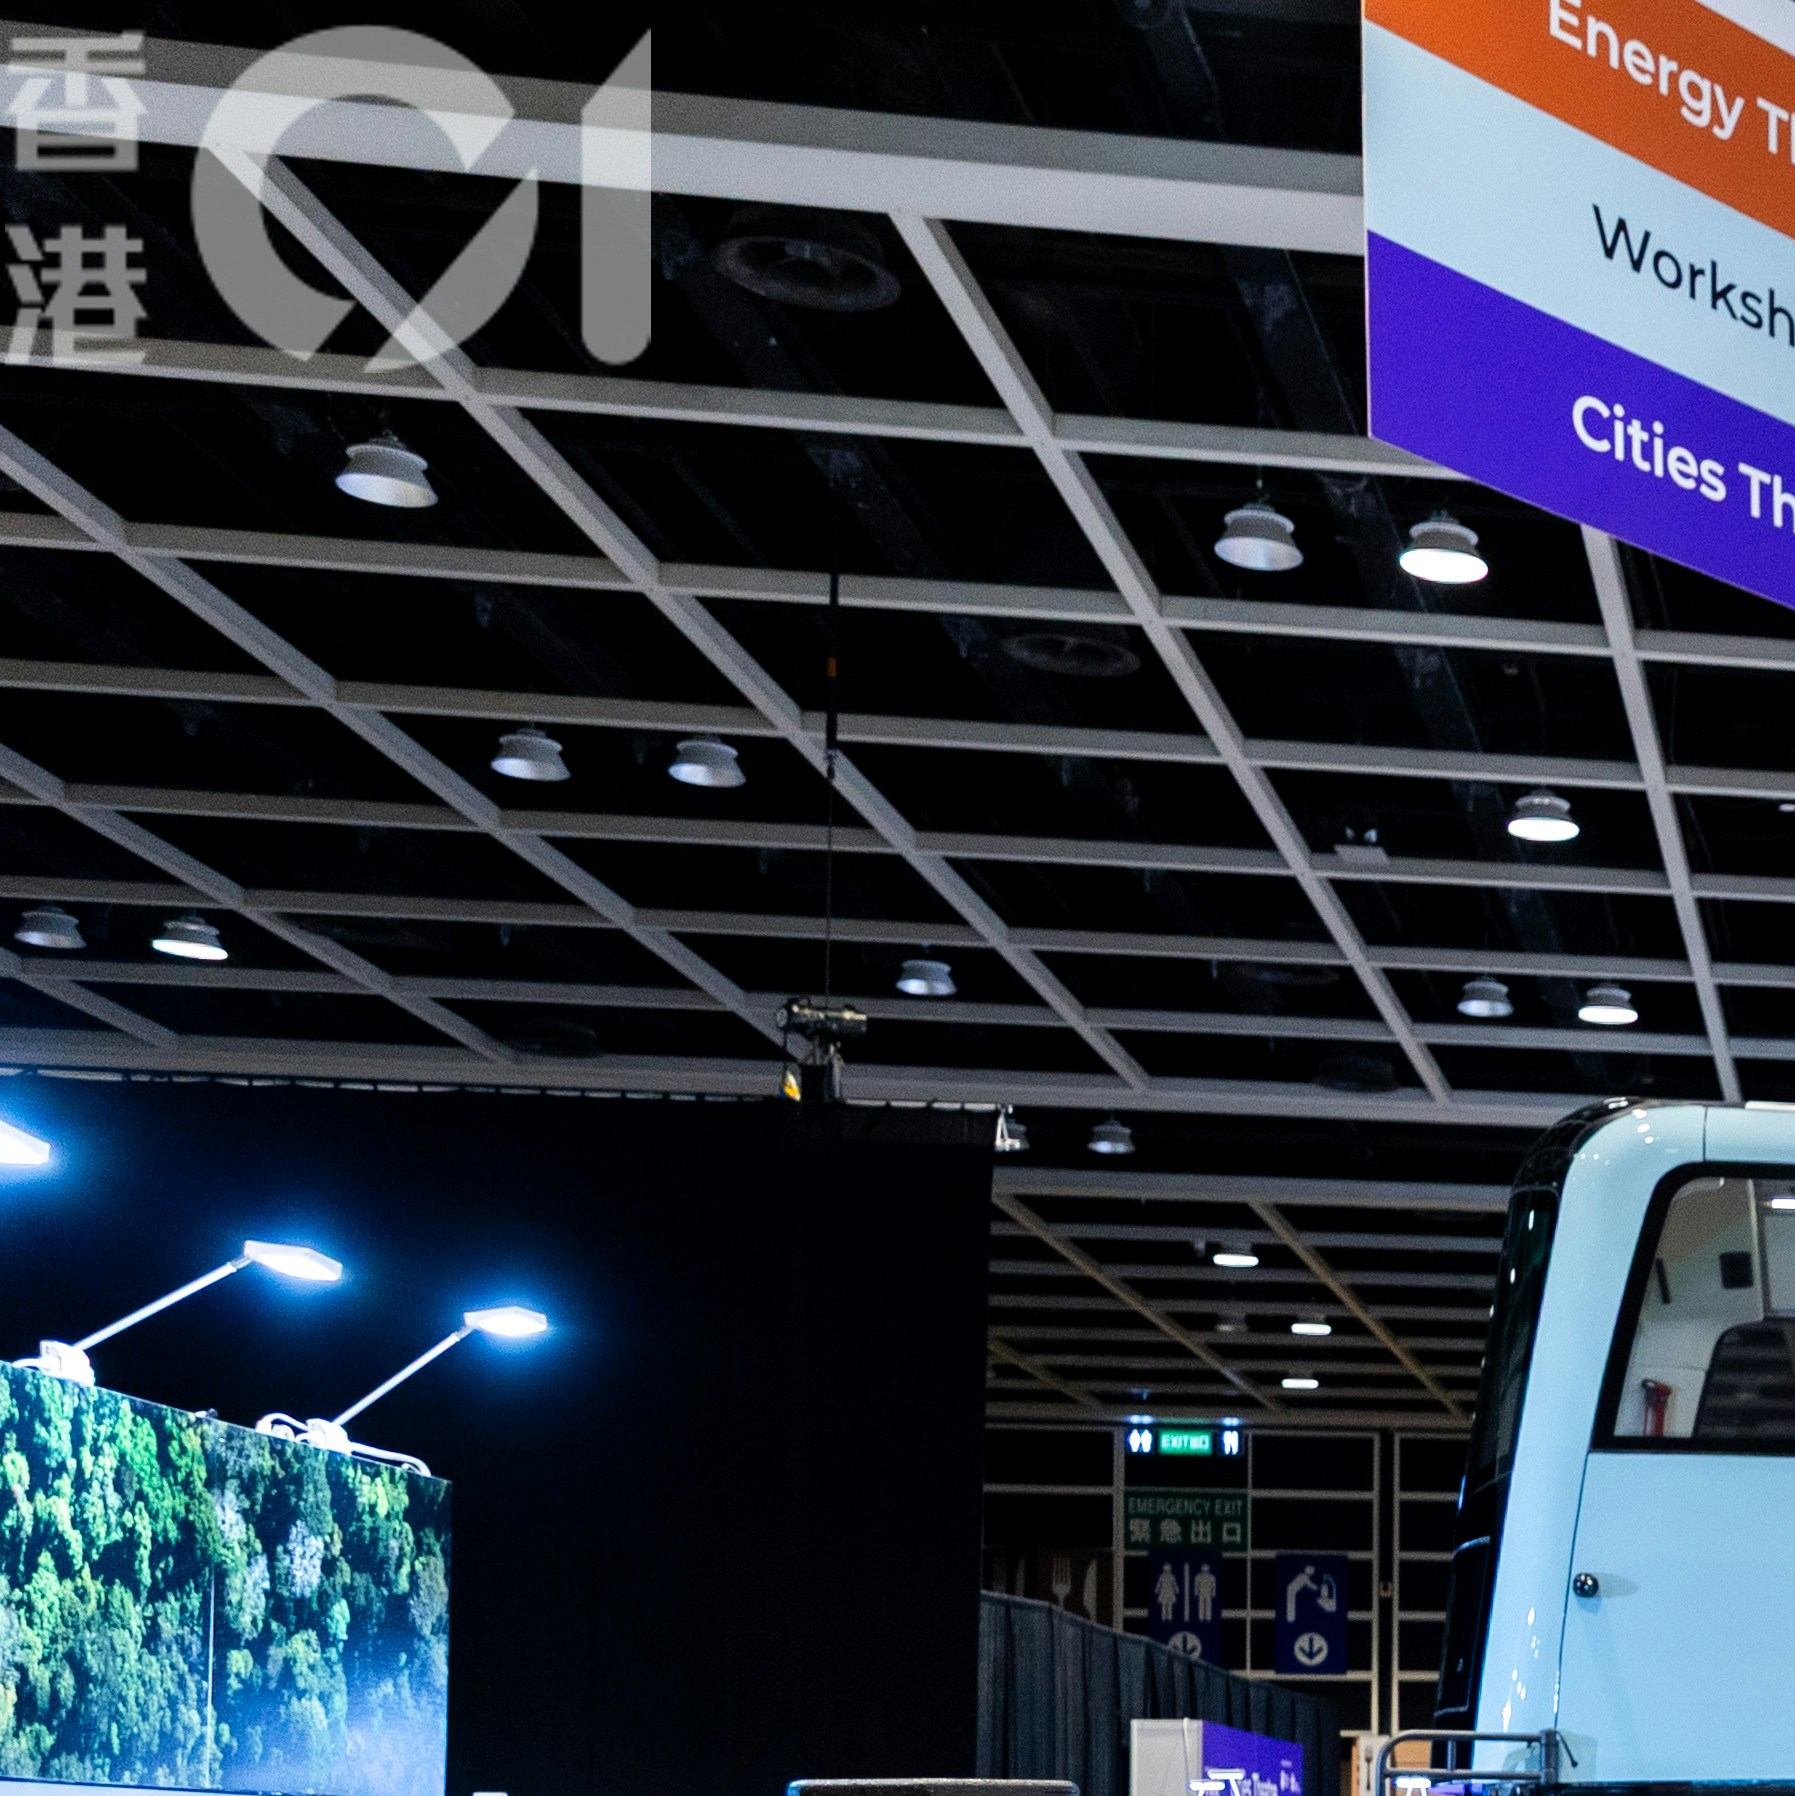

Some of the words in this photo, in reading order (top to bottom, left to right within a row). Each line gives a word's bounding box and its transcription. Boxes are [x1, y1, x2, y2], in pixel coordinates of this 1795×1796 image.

[1549, 0, 1745, 139] Energy
[1572, 395, 1728, 503] Cities
[1128, 1497, 1212, 1516] EMERGENCY
[1215, 1498, 1242, 1516] EXIT
[1129, 1519, 1242, 1543] 緊急出口
